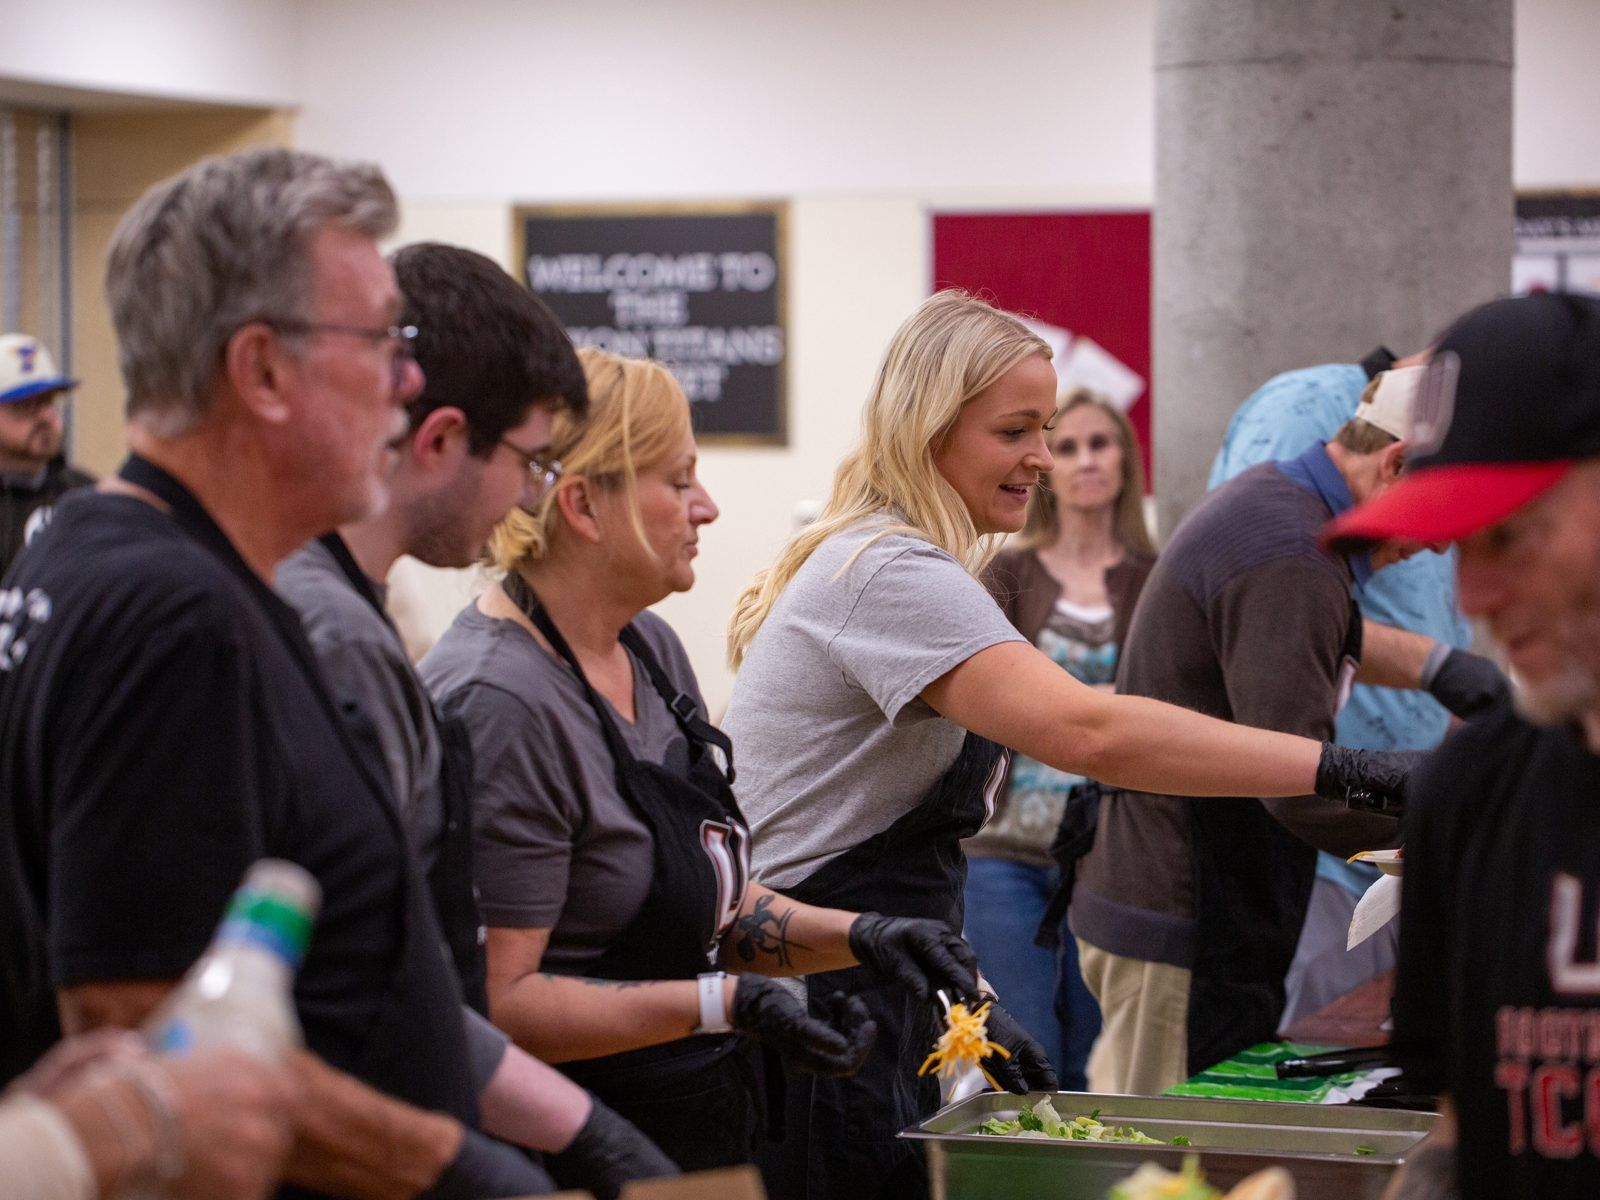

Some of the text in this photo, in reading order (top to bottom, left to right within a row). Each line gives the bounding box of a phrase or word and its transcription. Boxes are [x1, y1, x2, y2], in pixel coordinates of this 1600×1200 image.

[528, 253, 776, 292] WELCOME TO
[608, 291, 688, 325] THE
[652, 326, 784, 365] TITANS
